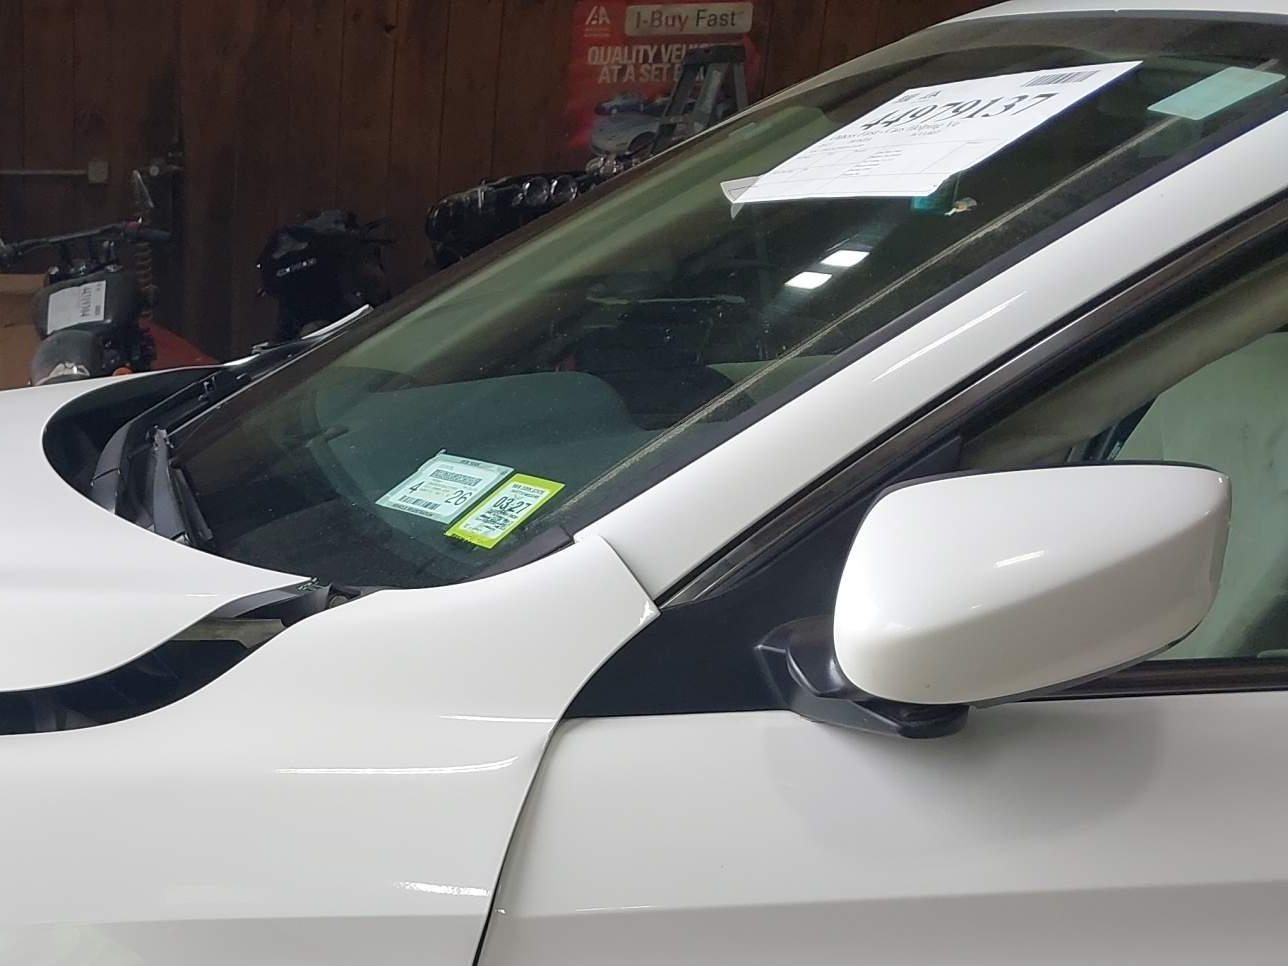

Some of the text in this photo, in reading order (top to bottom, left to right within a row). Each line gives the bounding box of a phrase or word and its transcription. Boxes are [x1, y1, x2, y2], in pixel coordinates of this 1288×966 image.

[635, 9, 737, 32] I-Buy Fast
[587, 45, 661, 65] QUALITY
[598, 64, 621, 84] AT
[621, 64, 635, 83] A
[639, 63, 670, 83] SET
[862, 92, 1060, 130] 44979137
[409, 481, 425, 494] 4
[444, 489, 472, 506] 26
